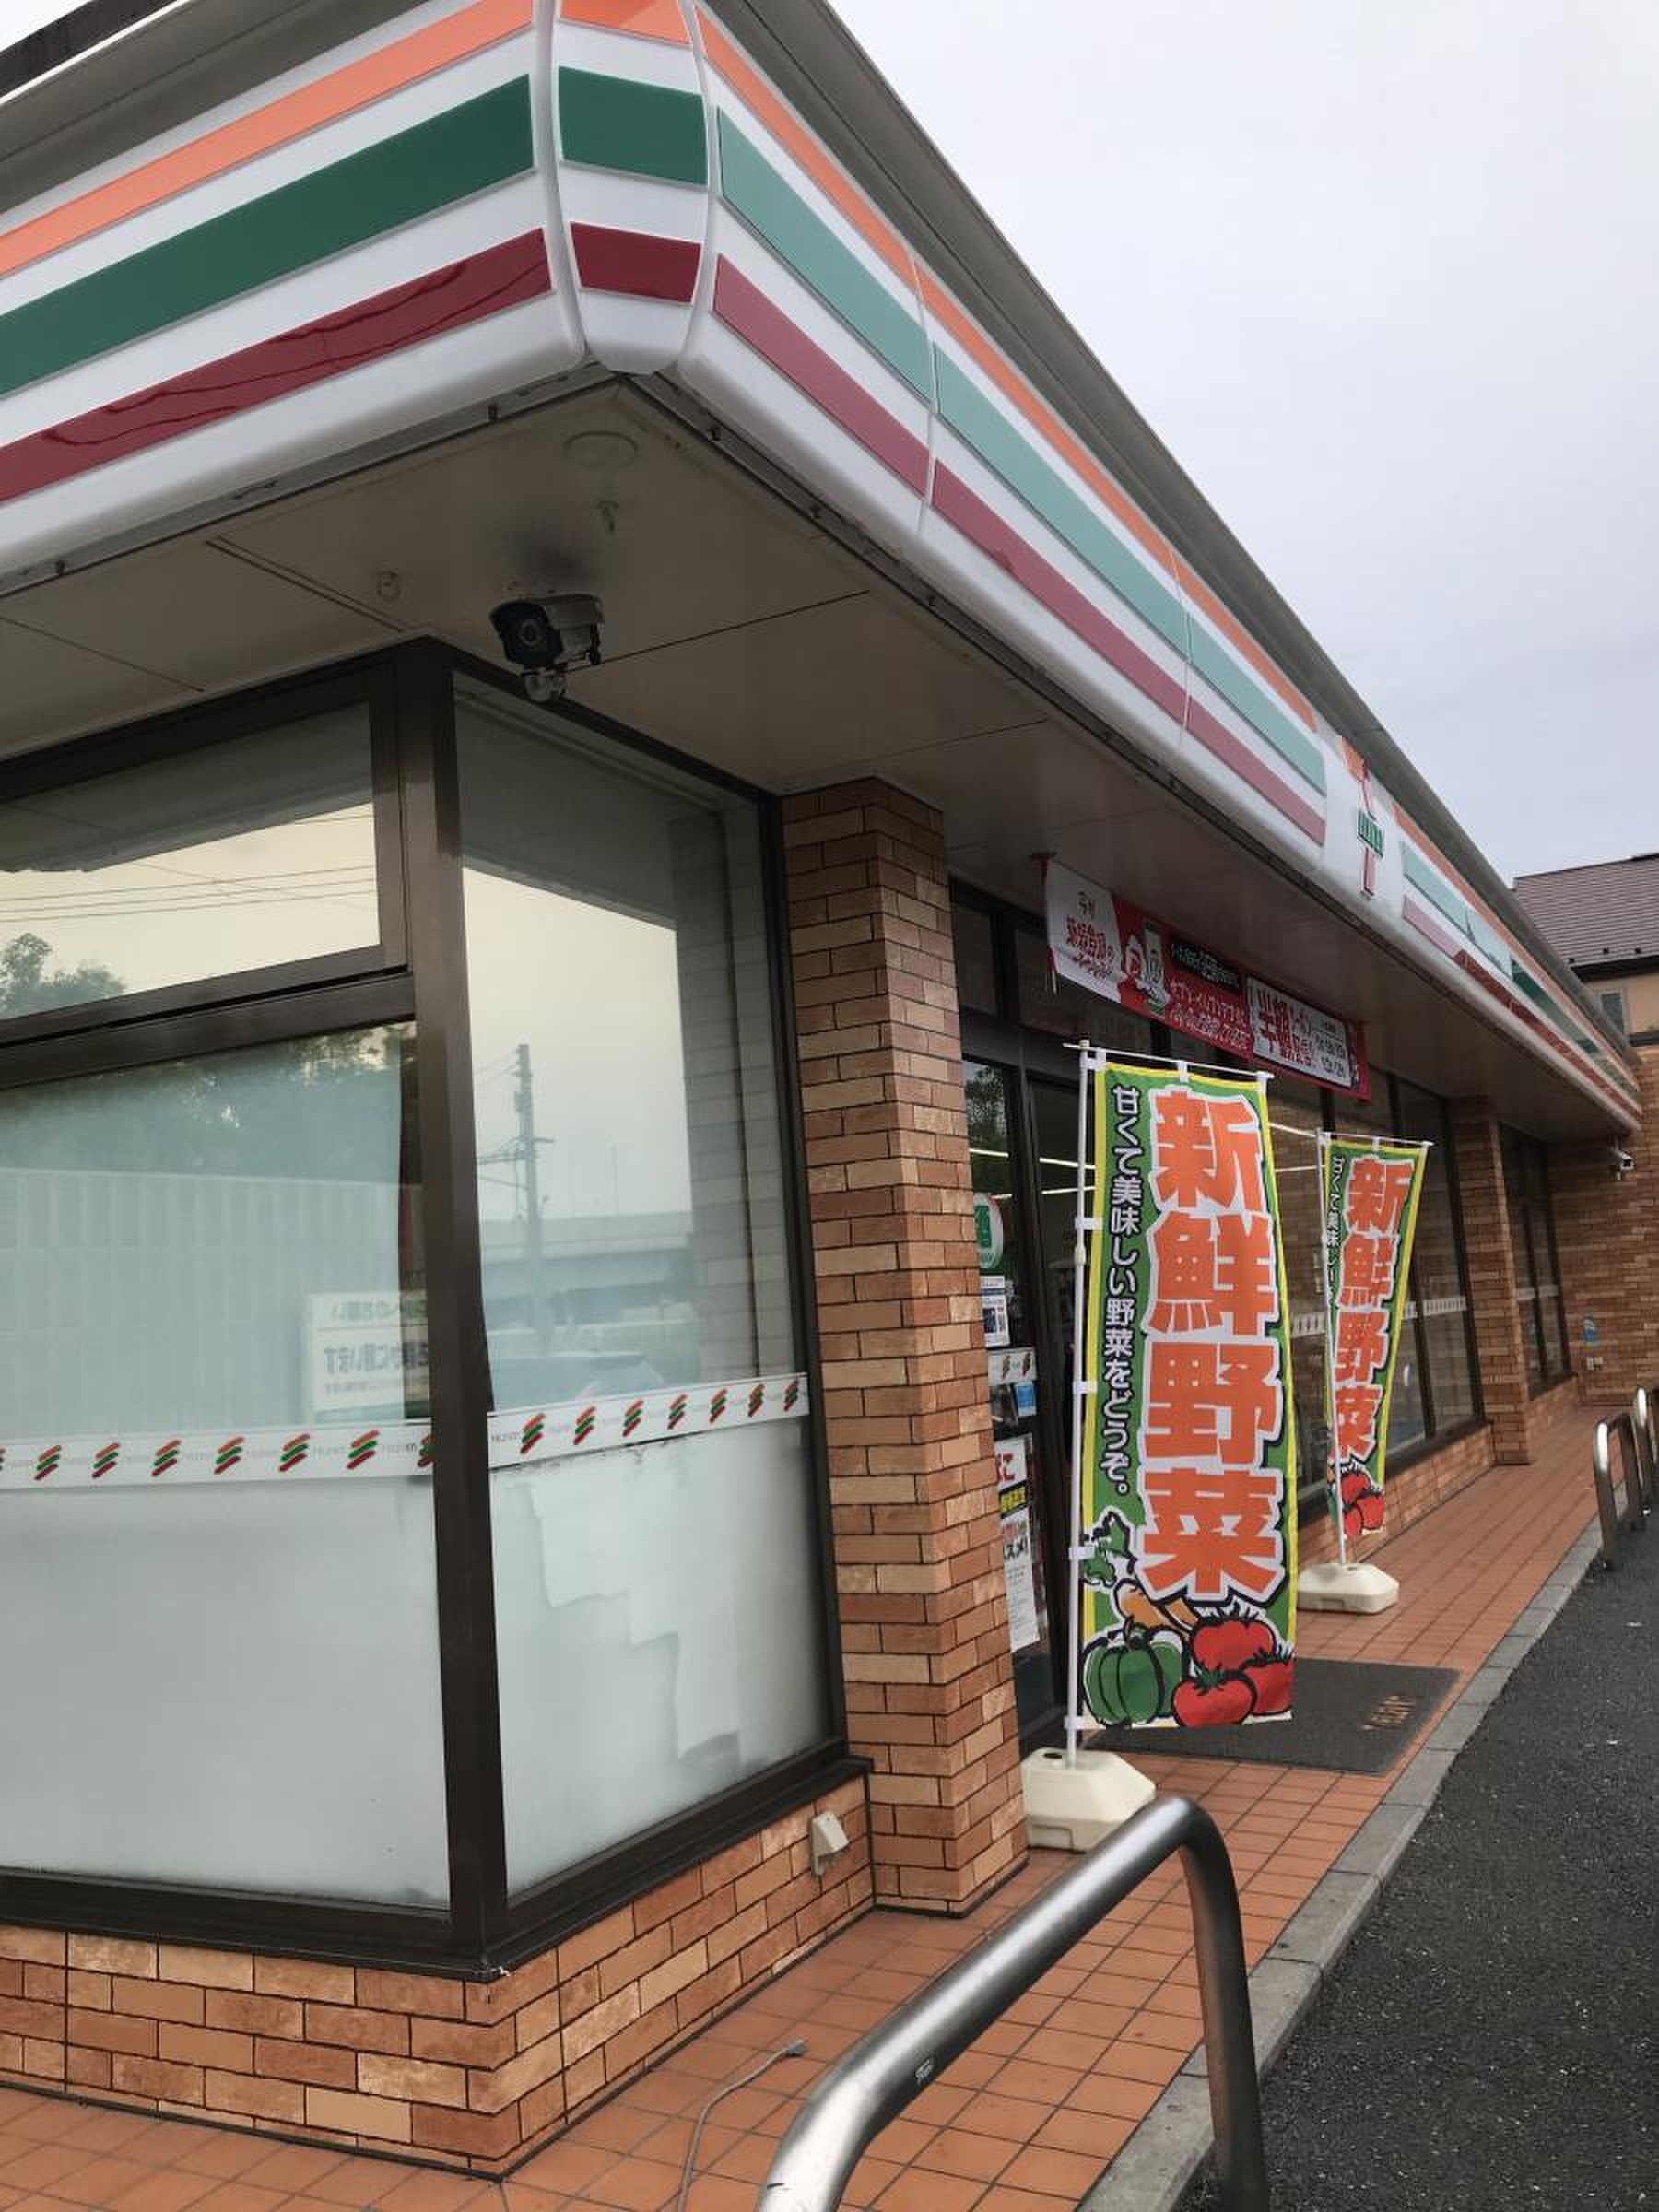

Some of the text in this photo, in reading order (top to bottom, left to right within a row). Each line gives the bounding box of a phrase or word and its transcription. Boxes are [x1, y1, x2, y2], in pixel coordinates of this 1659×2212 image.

[1100, 1085, 1142, 1496] 甘くて美味しい野菜をどうぞ。
[1140, 1088, 1284, 1597] 新鮮野菜
[1329, 1157, 1415, 1460] 新鮮野菜
